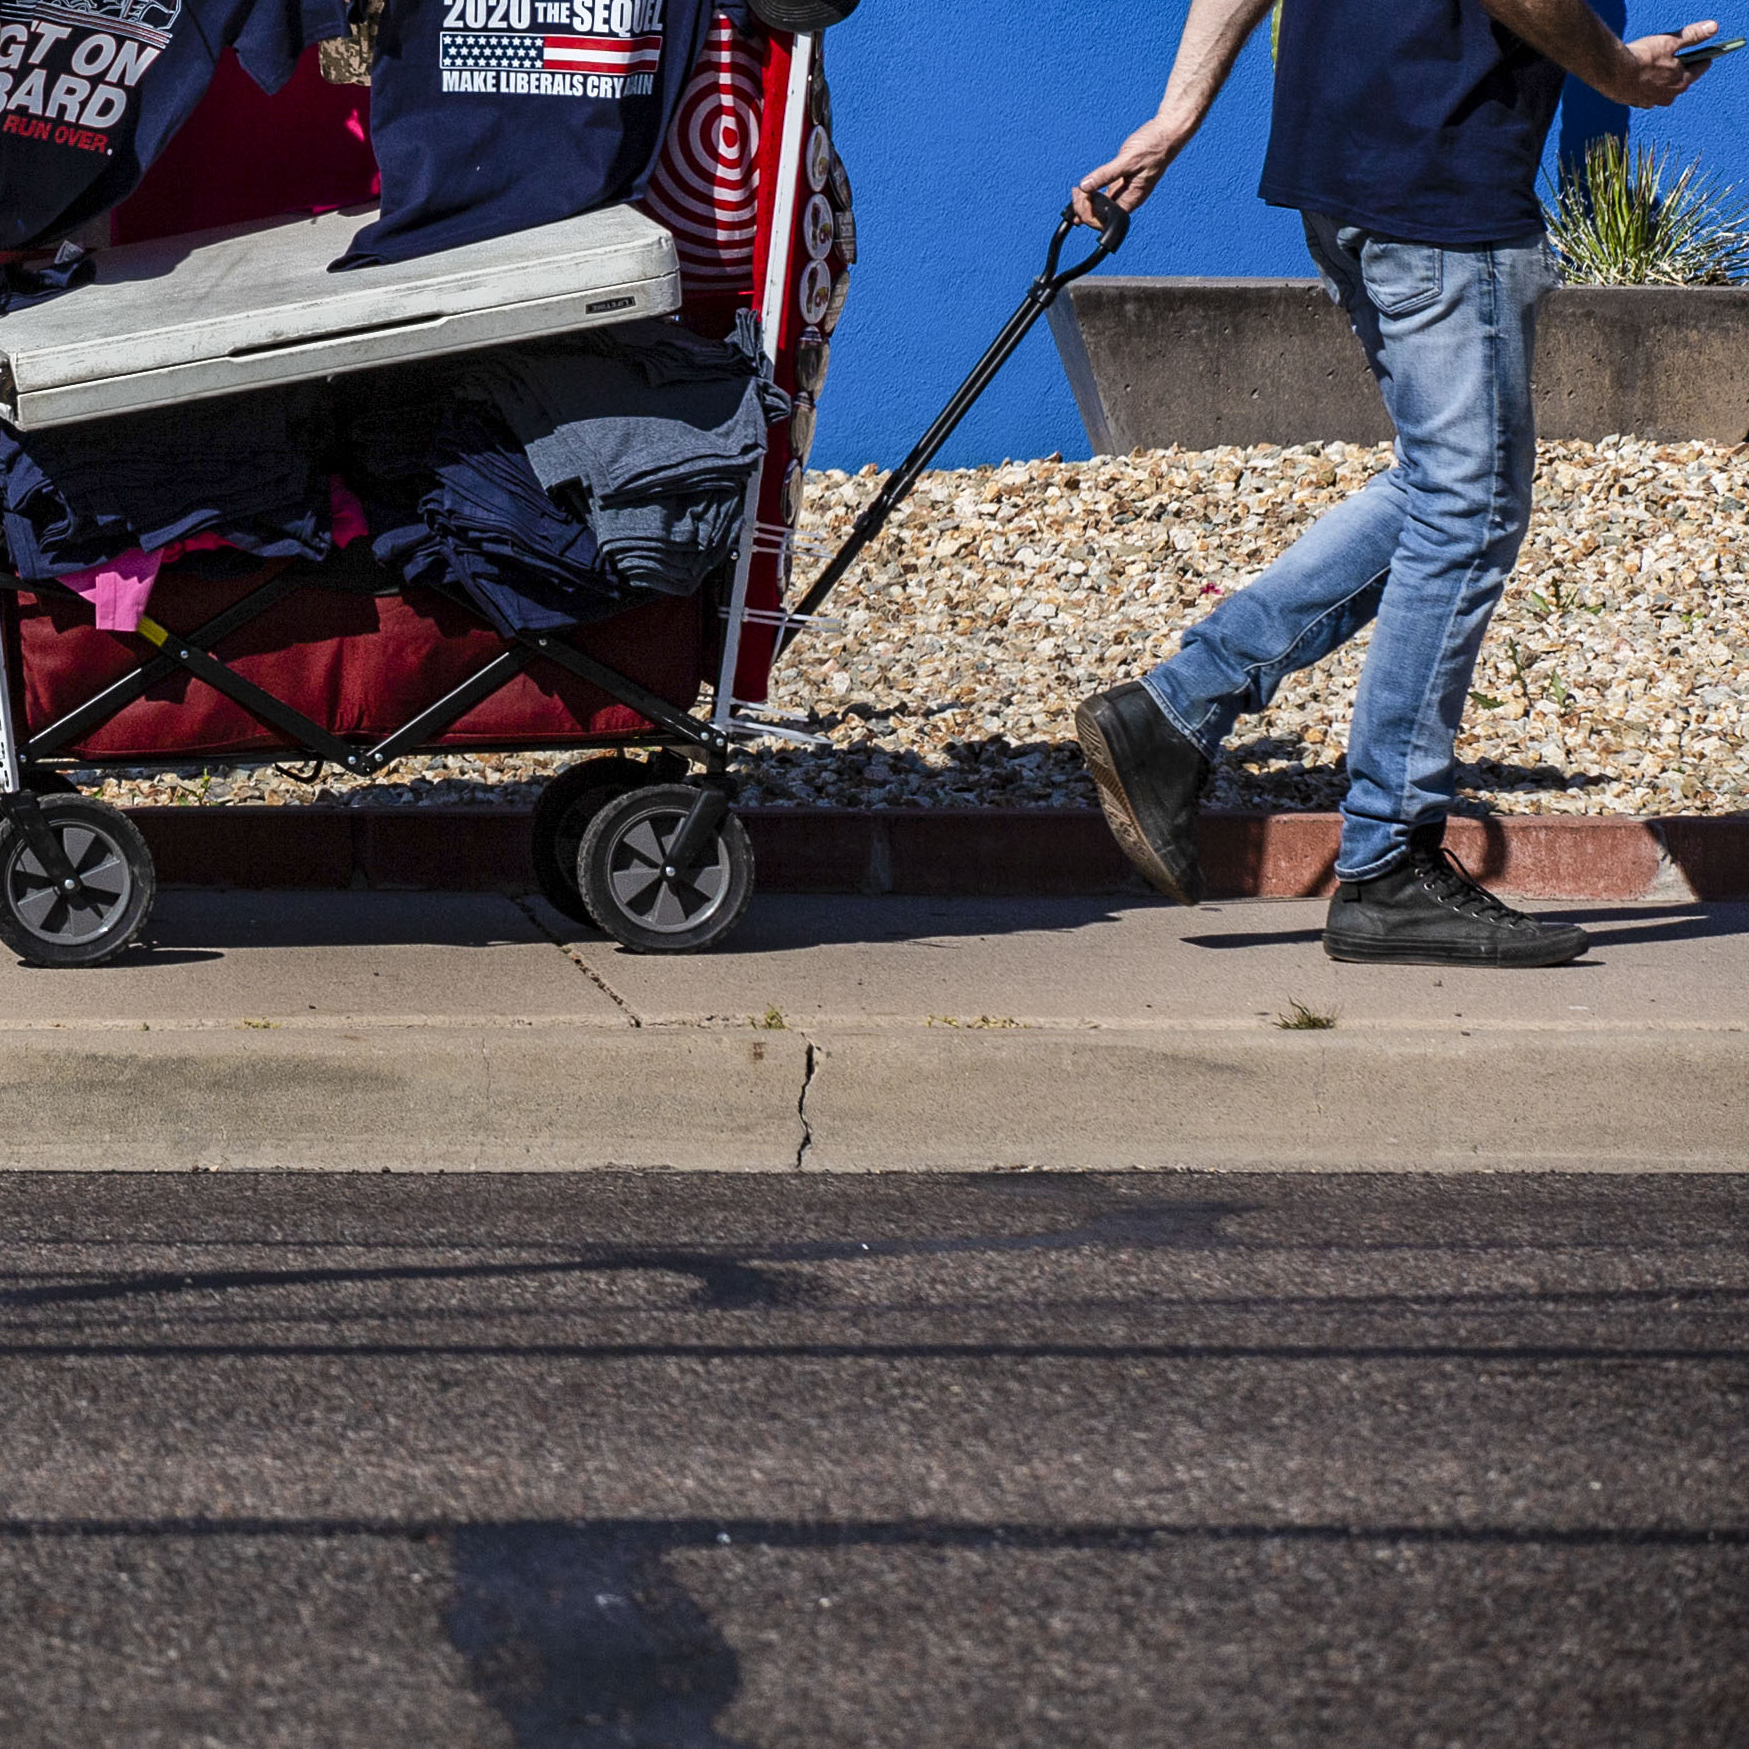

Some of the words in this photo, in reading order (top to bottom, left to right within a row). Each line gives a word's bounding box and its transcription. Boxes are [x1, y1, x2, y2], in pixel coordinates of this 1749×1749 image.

[535, 2, 571, 24] THE
[71, 34, 162, 86] ON
[442, 71, 497, 92] MAKE
[499, 74, 585, 96] LIBERALS
[586, 77, 625, 99] CRY
[2, 114, 51, 141] RUN
